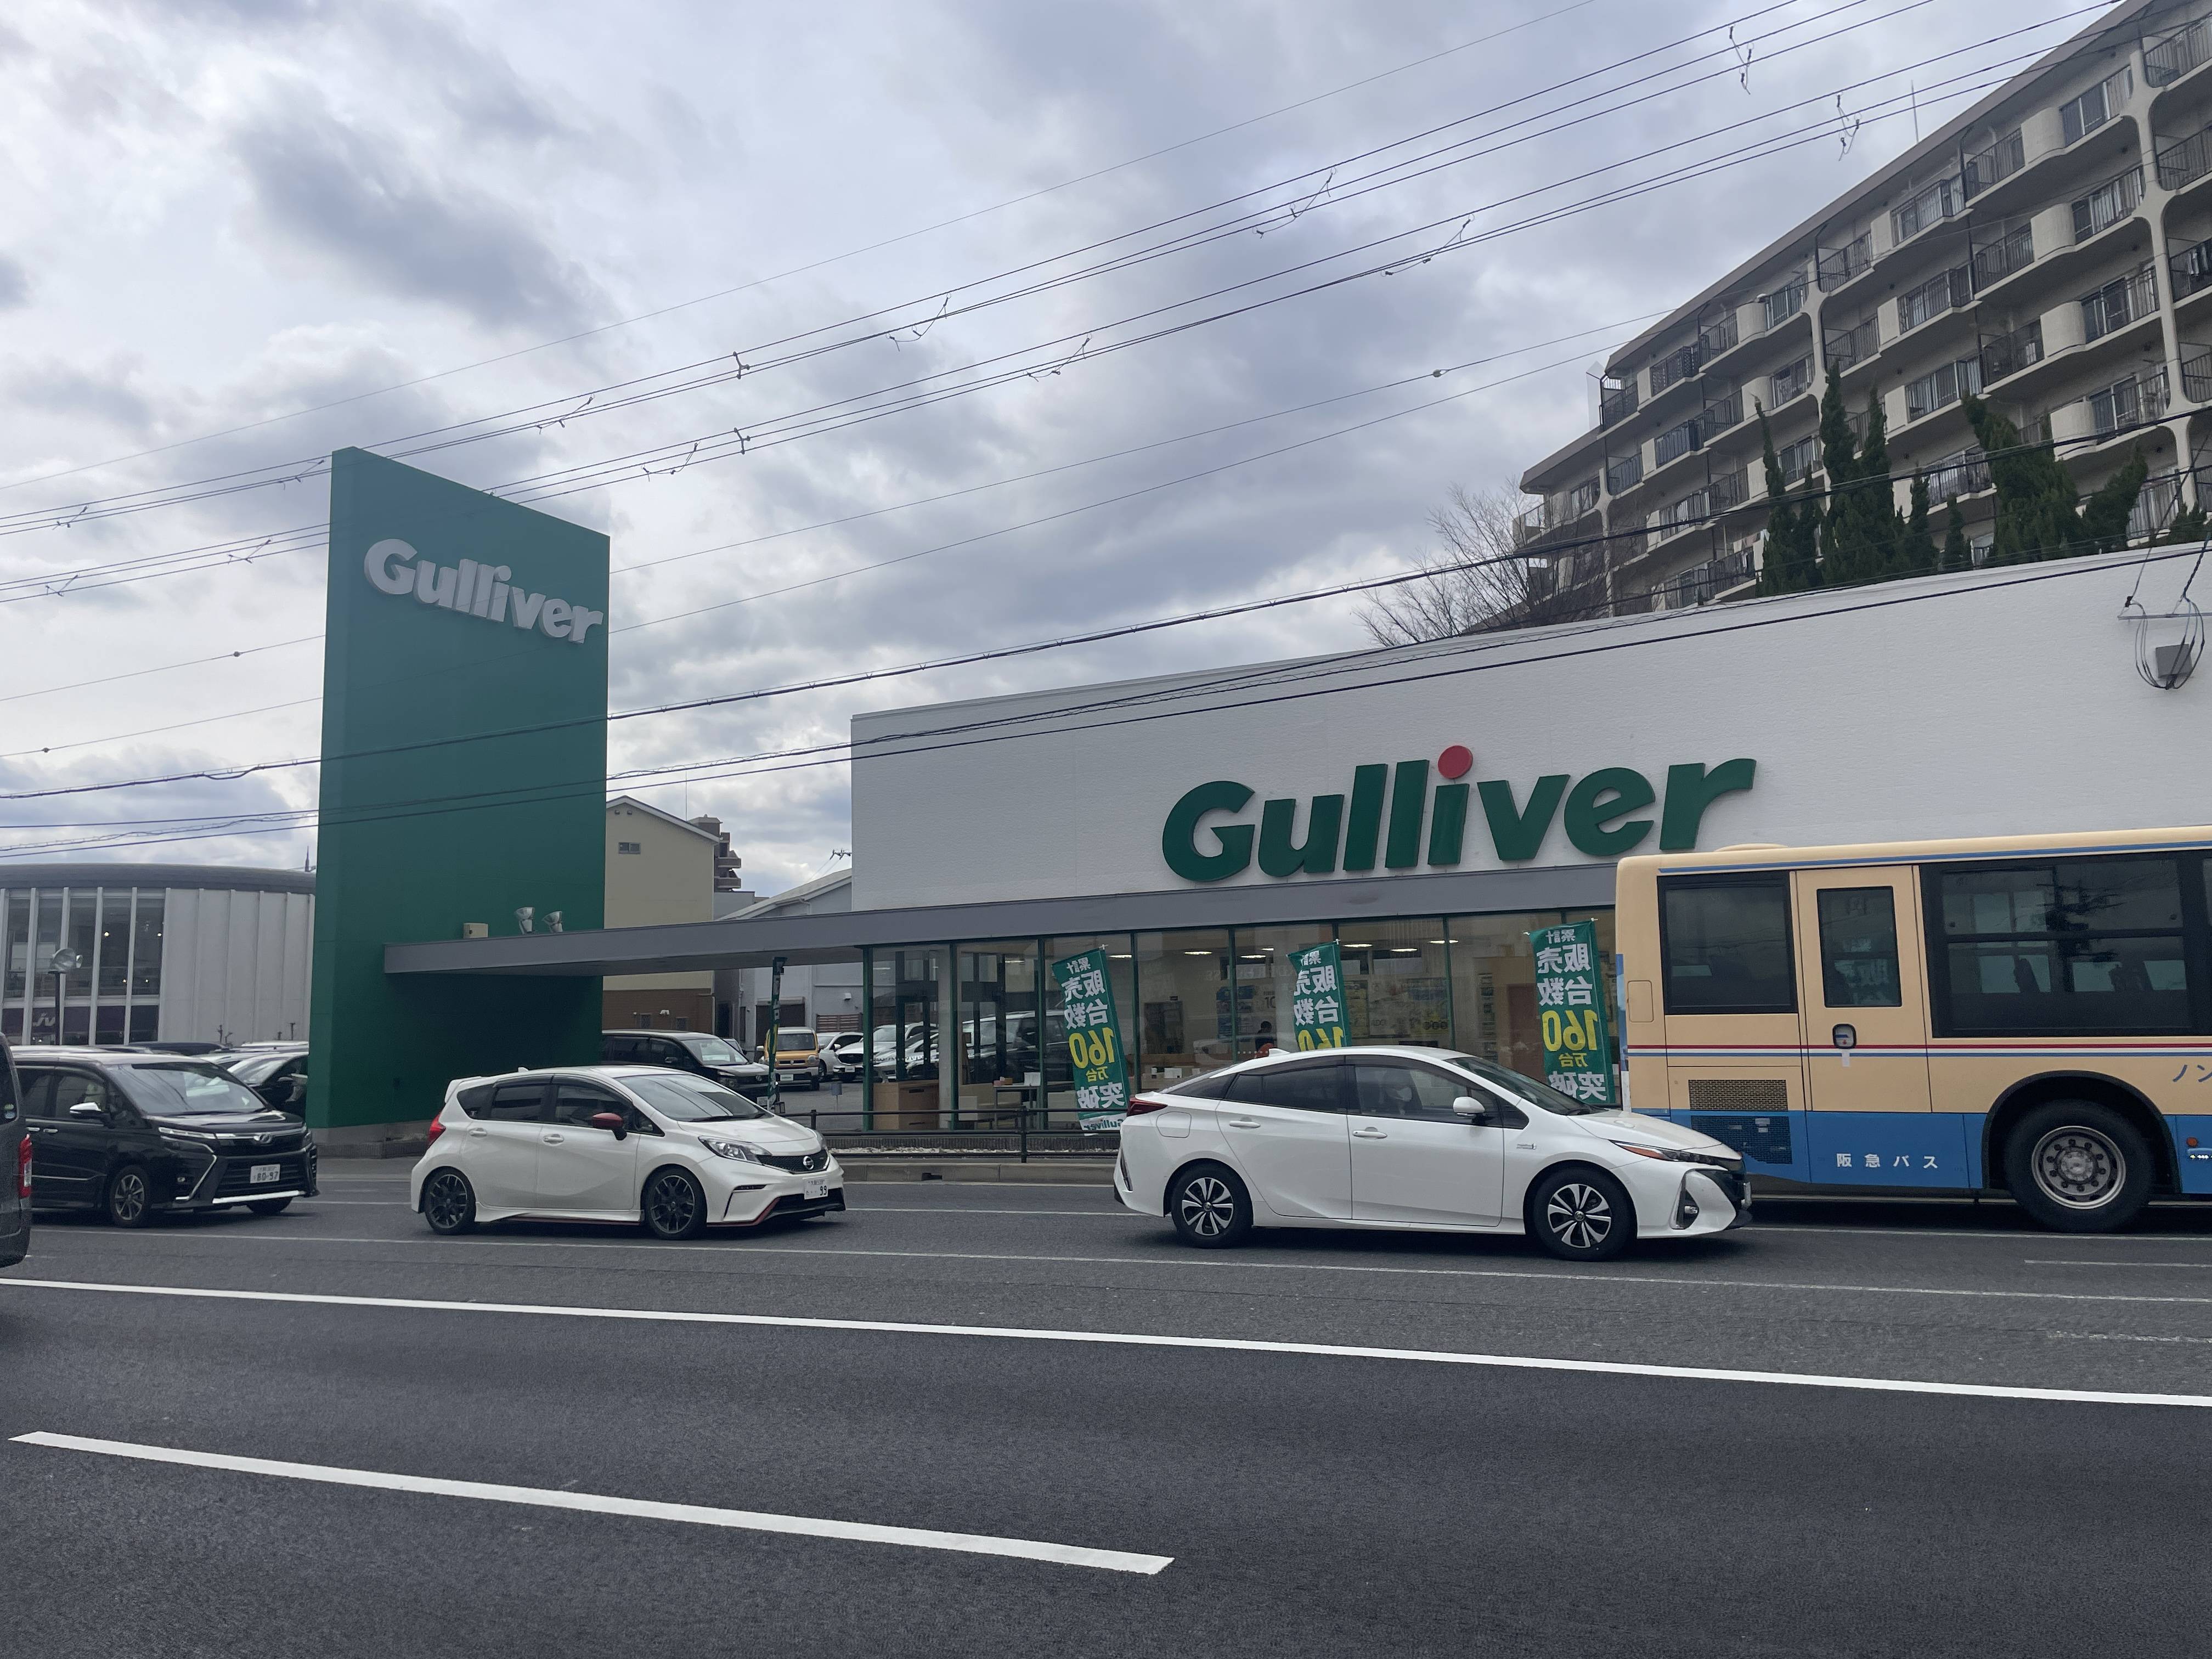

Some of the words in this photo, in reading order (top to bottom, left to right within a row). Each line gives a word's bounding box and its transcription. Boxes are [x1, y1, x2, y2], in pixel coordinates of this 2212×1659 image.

[364, 538, 603, 644] Gulliver
[1162, 744, 1757, 882] Gulliver
[1836, 1153, 1938, 1169] 阪急バス
